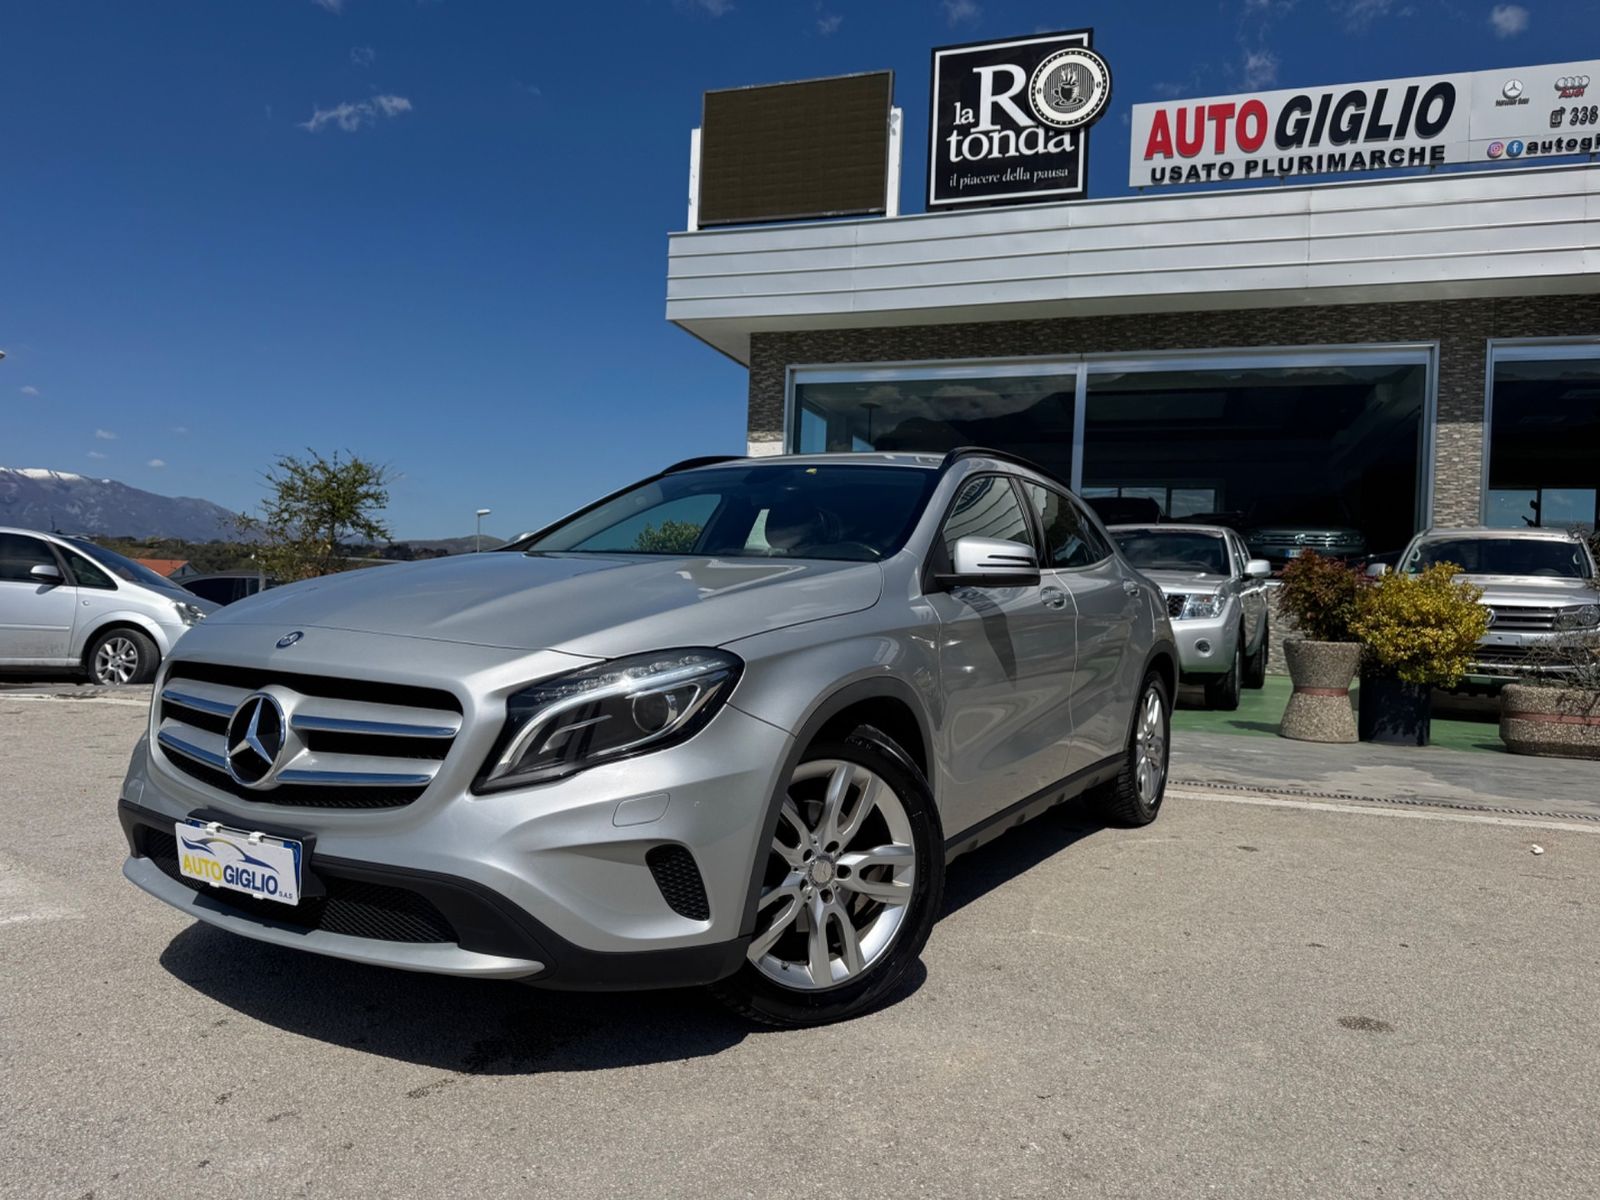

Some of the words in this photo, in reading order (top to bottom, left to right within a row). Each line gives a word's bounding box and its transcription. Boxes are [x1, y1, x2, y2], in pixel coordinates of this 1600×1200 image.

[953, 102, 975, 125] la
[1144, 99, 1268, 160] AUTO
[1274, 81, 1456, 150] GIGLIO
[946, 126, 1075, 163] tonda
[949, 173, 957, 187] il
[960, 174, 1000, 190] piacere
[1002, 167, 1030, 182] della
[1033, 168, 1068, 183] pausa
[1150, 161, 1234, 184] USATO
[1244, 145, 1445, 176] PLURIMARCHE
